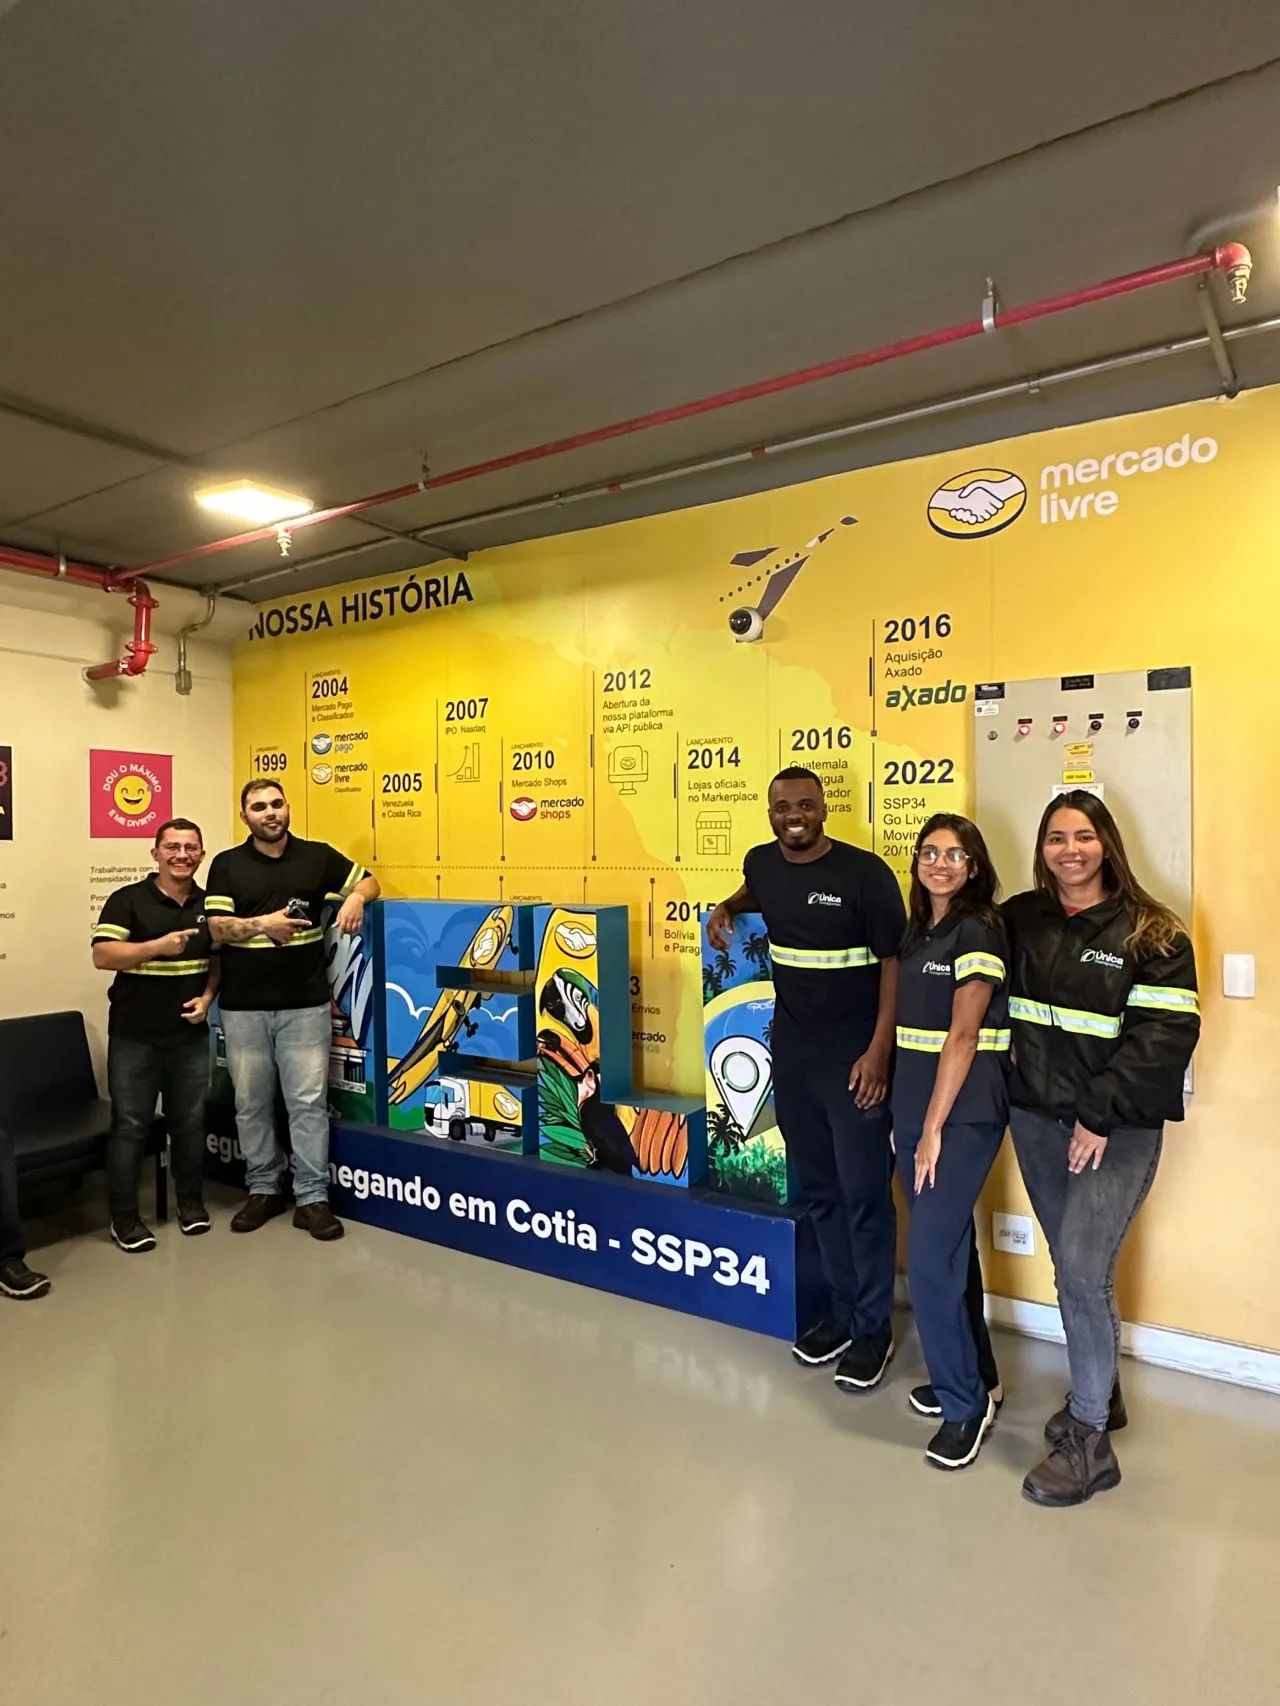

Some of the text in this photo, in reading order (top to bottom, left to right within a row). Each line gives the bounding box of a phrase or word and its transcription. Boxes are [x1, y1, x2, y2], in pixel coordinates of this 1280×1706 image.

[1040, 432, 1218, 491] mercado
[1040, 489, 1119, 525] livre
[249, 571, 474, 641] NOSSA HISTÓRIA
[884, 613, 952, 644] 2016
[884, 648, 943, 665] Aquisição
[884, 665, 923, 679] Axado
[311, 675, 349, 699] 2004
[603, 668, 651, 693] 2012
[311, 701, 353, 713] Mercado Pago
[445, 697, 489, 721] 2007
[602, 697, 651, 710] Abertura da
[316, 711, 354, 722] Classificados
[602, 709, 674, 722] nossa plataforma
[445, 724, 486, 735] IPO Nasdaq
[602, 721, 663, 734] via API pública
[334, 730, 369, 743] mercado
[686, 736, 734, 747] LANÇAMENTO
[791, 726, 852, 751] 2016
[334, 742, 354, 754] pago
[254, 752, 288, 773] 1999
[512, 750, 555, 771] 2010
[687, 746, 741, 770] 2014
[334, 761, 368, 773] mercado
[883, 758, 955, 785] 2022
[102, 763, 162, 793] DOU O MÁXIMO
[334, 773, 350, 784] livre
[382, 772, 422, 794] 2005
[511, 777, 567, 788] Mercado Shops
[687, 779, 746, 792] Lojas oficiais
[381, 799, 414, 808] Venezuela
[540, 796, 585, 809] mercado
[687, 794, 700, 803] no
[883, 797, 926, 810] SSP34
[108, 809, 117, 818] E
[387, 809, 406, 819] Costa
[406, 808, 422, 818] Rica
[540, 809, 571, 821] shops
[883, 814, 901, 825] Go
[883, 829, 919, 841] Movin
[819, 891, 842, 903] Única
[664, 943, 701, 956] e Parag
[1095, 949, 1124, 965] Única
[631, 1030, 666, 1043] ercado
[449, 1192, 497, 1226] em
[506, 1198, 598, 1252] Cotia
[608, 1238, 621, 1249] -
[631, 1227, 770, 1295] SSP34
